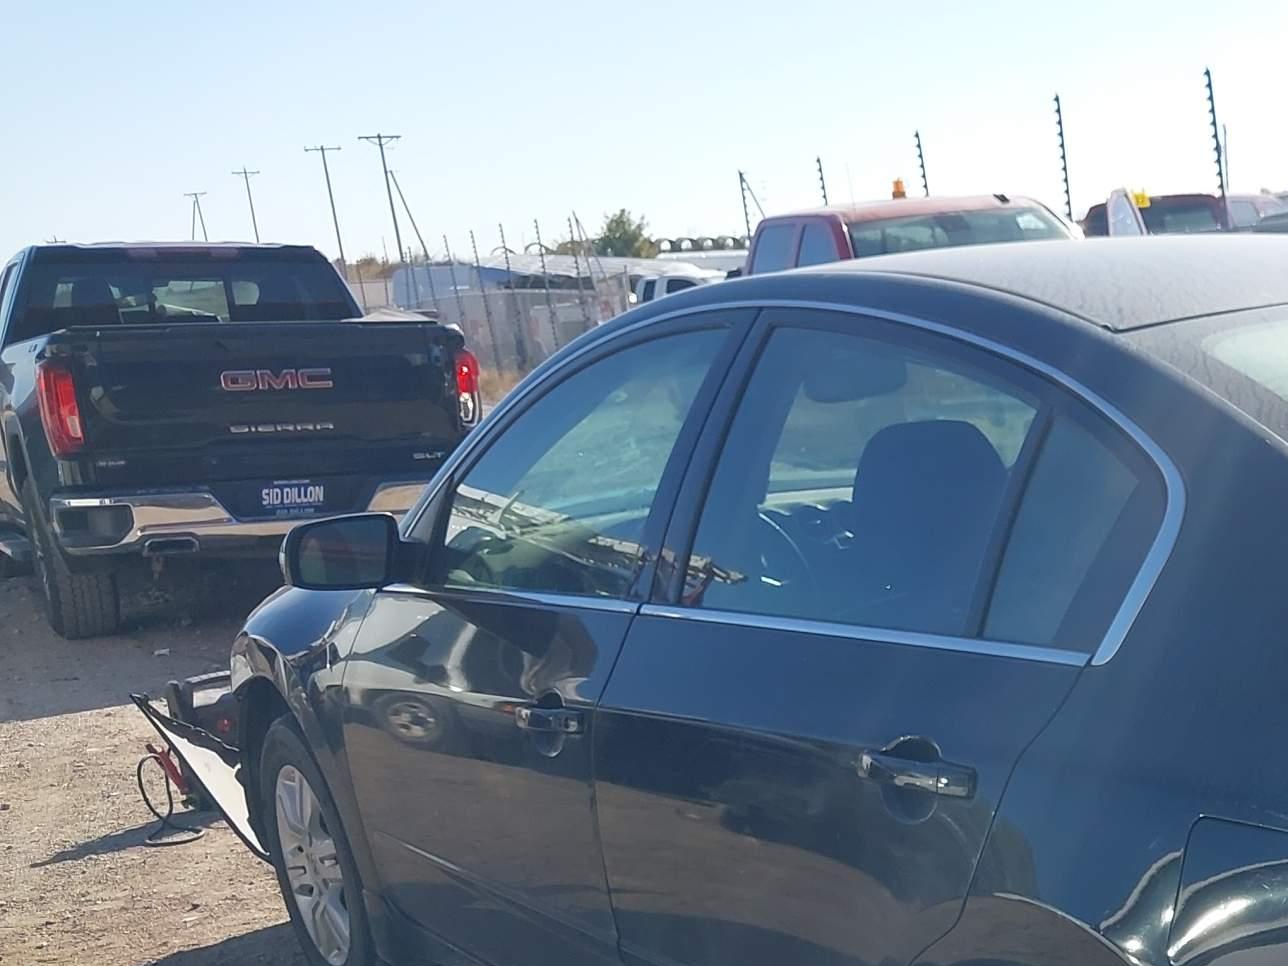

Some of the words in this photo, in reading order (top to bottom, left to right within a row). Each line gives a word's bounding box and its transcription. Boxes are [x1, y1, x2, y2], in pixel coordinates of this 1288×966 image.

[220, 367, 333, 391] GMC
[229, 422, 334, 433] SIERRA
[261, 488, 281, 505] SID
[283, 485, 324, 504] DILLON
